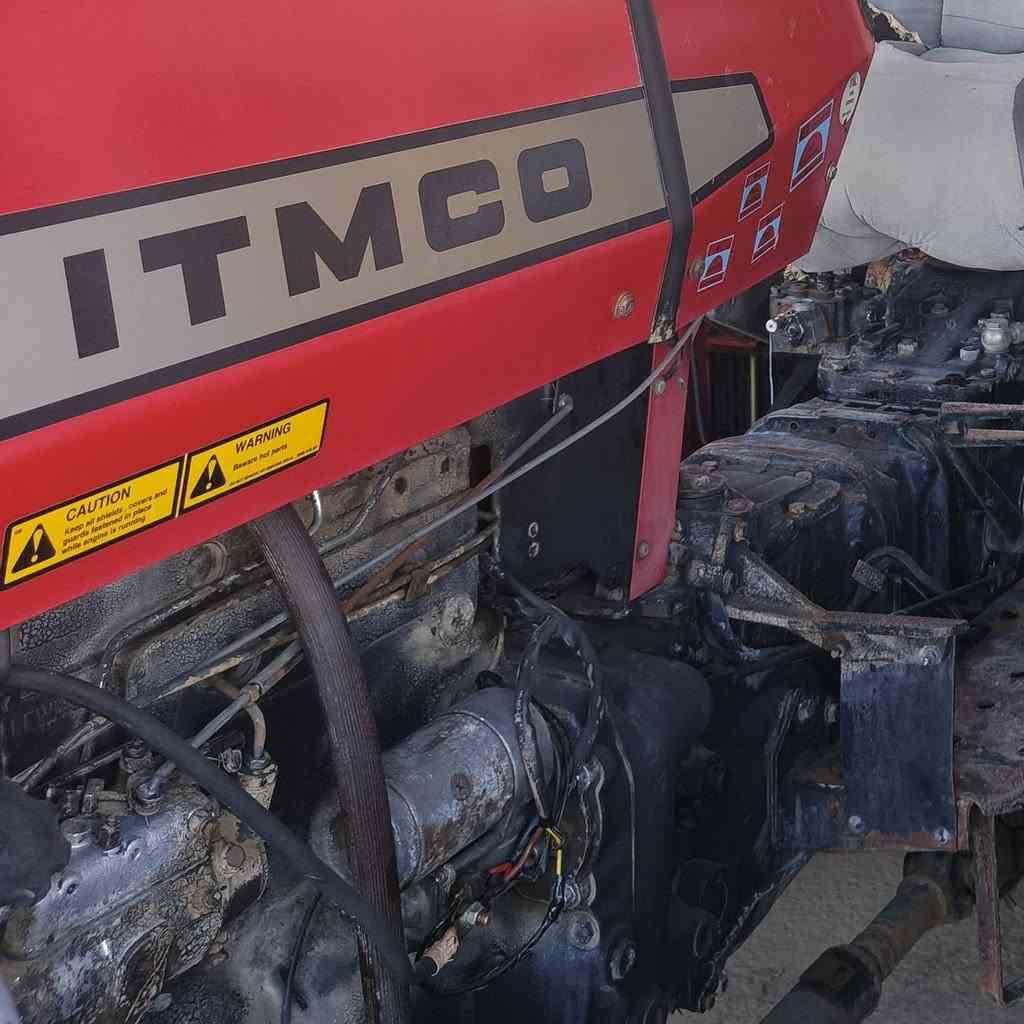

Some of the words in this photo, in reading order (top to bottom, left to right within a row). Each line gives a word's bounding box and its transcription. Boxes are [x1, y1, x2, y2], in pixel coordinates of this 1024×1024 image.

[62, 137, 593, 360] ITMCO
[235, 422, 292, 454] WARNING
[65, 486, 132, 521] CAUTION
[153, 488, 168, 499] and
